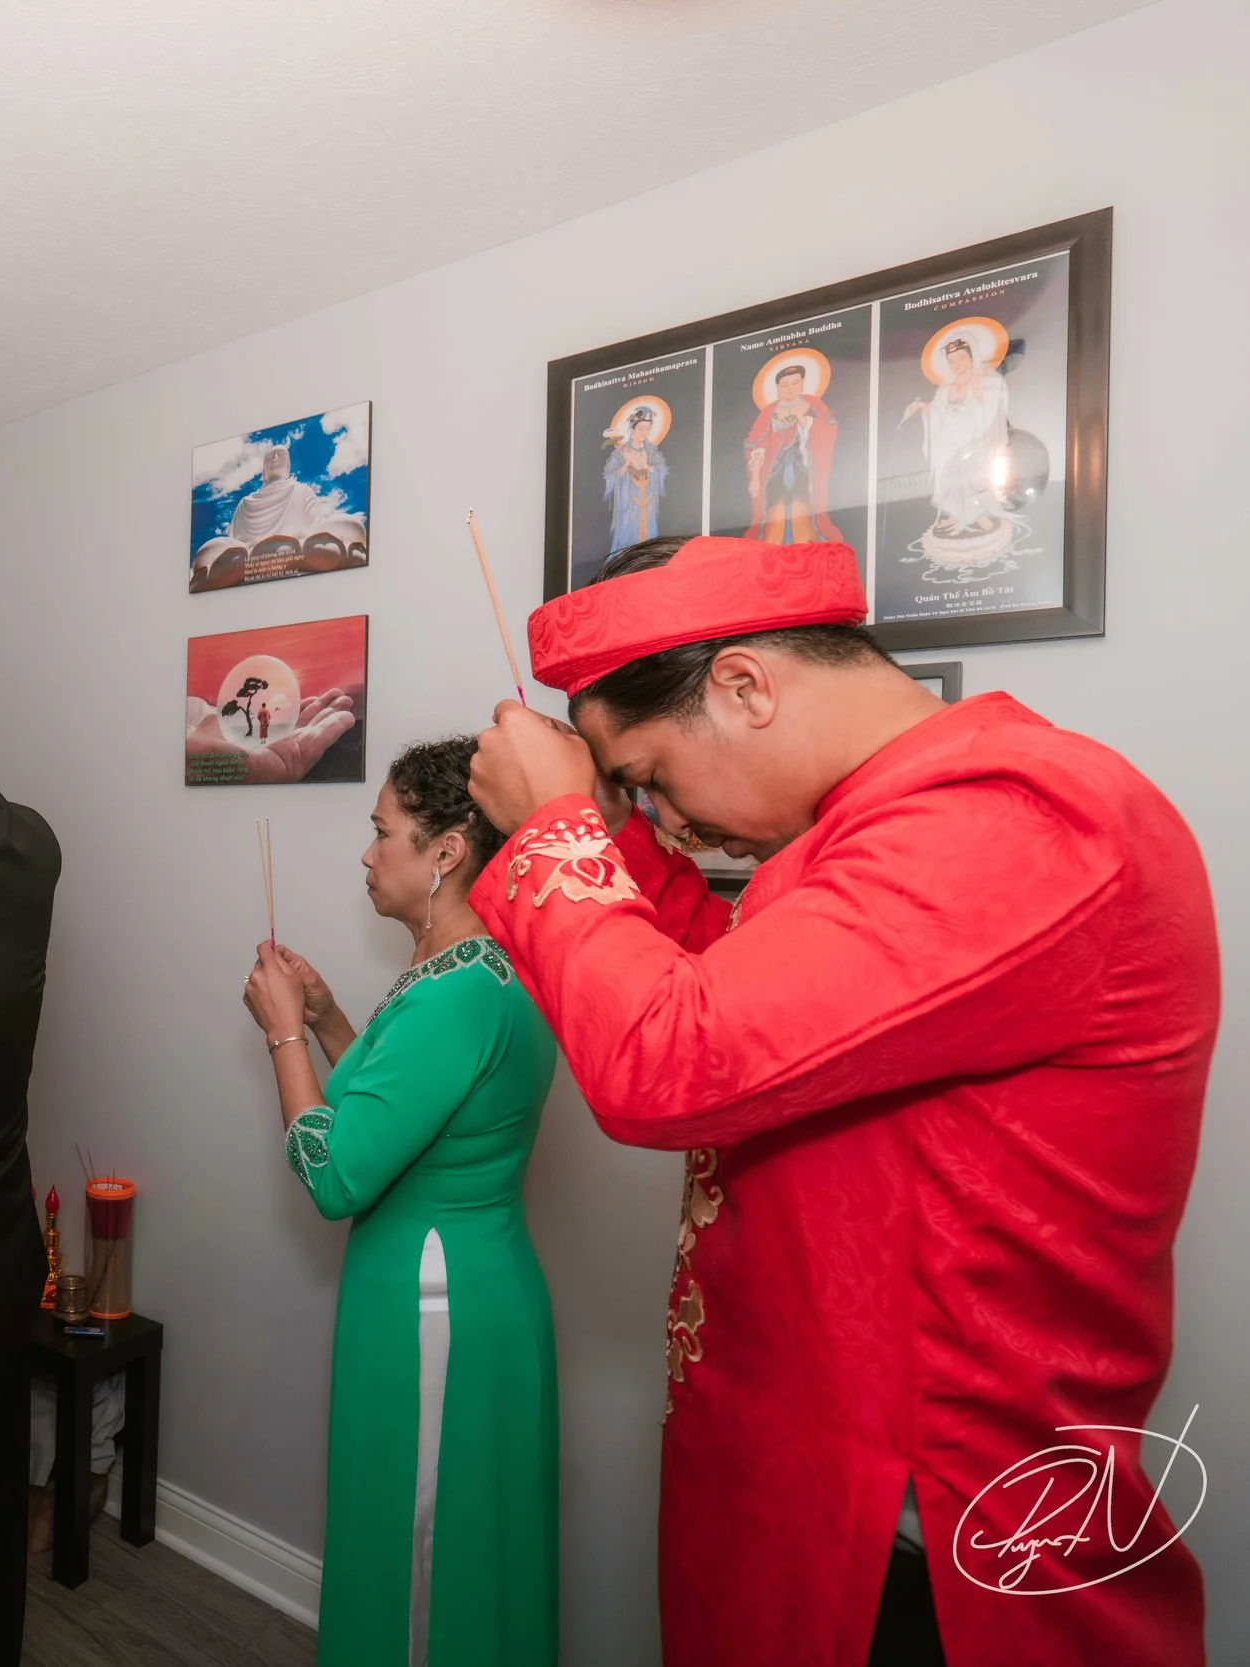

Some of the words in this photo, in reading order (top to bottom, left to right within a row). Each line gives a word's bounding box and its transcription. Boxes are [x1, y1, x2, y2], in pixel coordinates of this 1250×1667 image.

[904, 291, 961, 311] Bodhisattva
[963, 271, 1038, 297] Avalokitesvara
[934, 289, 1005, 311] COMPASSION
[741, 341, 764, 352] Namo
[766, 331, 807, 346] Amitabha
[809, 321, 842, 335] Buddha
[769, 339, 810, 352] NIRVANA
[584, 376, 626, 392] Bodhisattva
[623, 377, 655, 388] WISDOM
